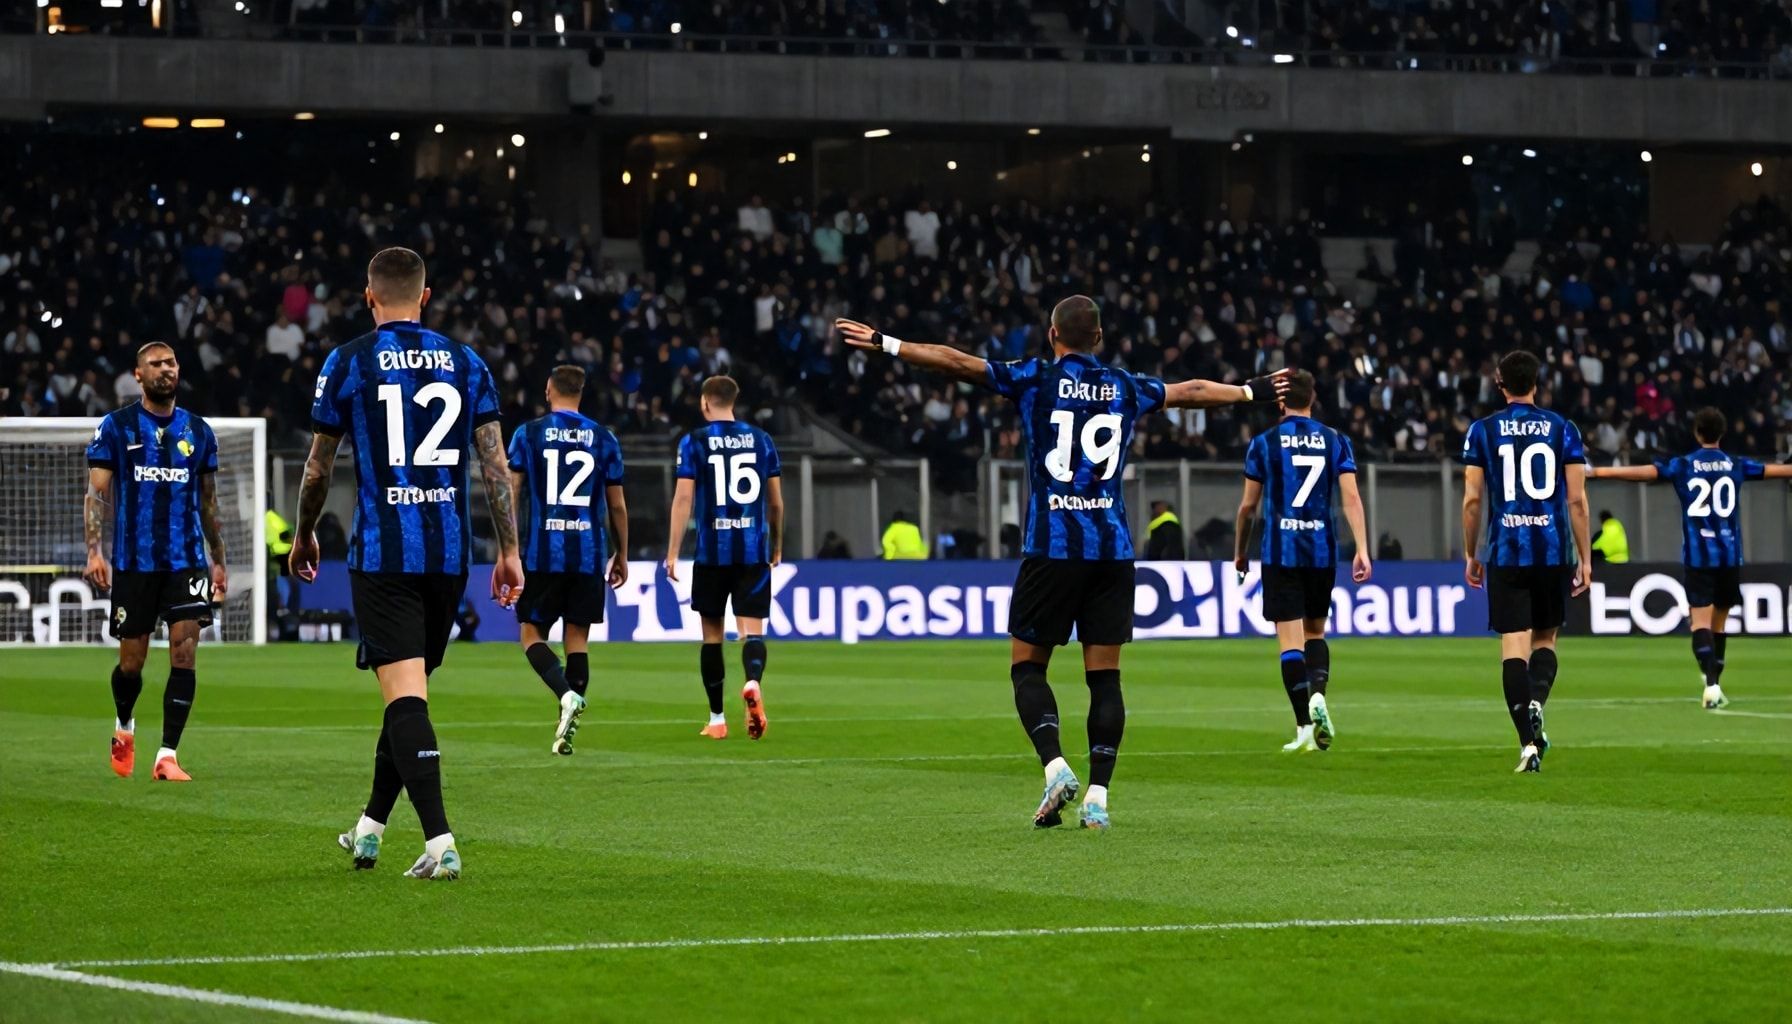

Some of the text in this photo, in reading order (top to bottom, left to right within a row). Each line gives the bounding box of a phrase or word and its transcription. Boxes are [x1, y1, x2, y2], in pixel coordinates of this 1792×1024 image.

[378, 382, 462, 467] 12
[1045, 410, 1123, 482] 19
[543, 449, 595, 507] 12
[708, 452, 761, 506] 16
[1291, 455, 1325, 507] 7
[1498, 442, 1556, 502] 10
[1687, 476, 1736, 518] 20
